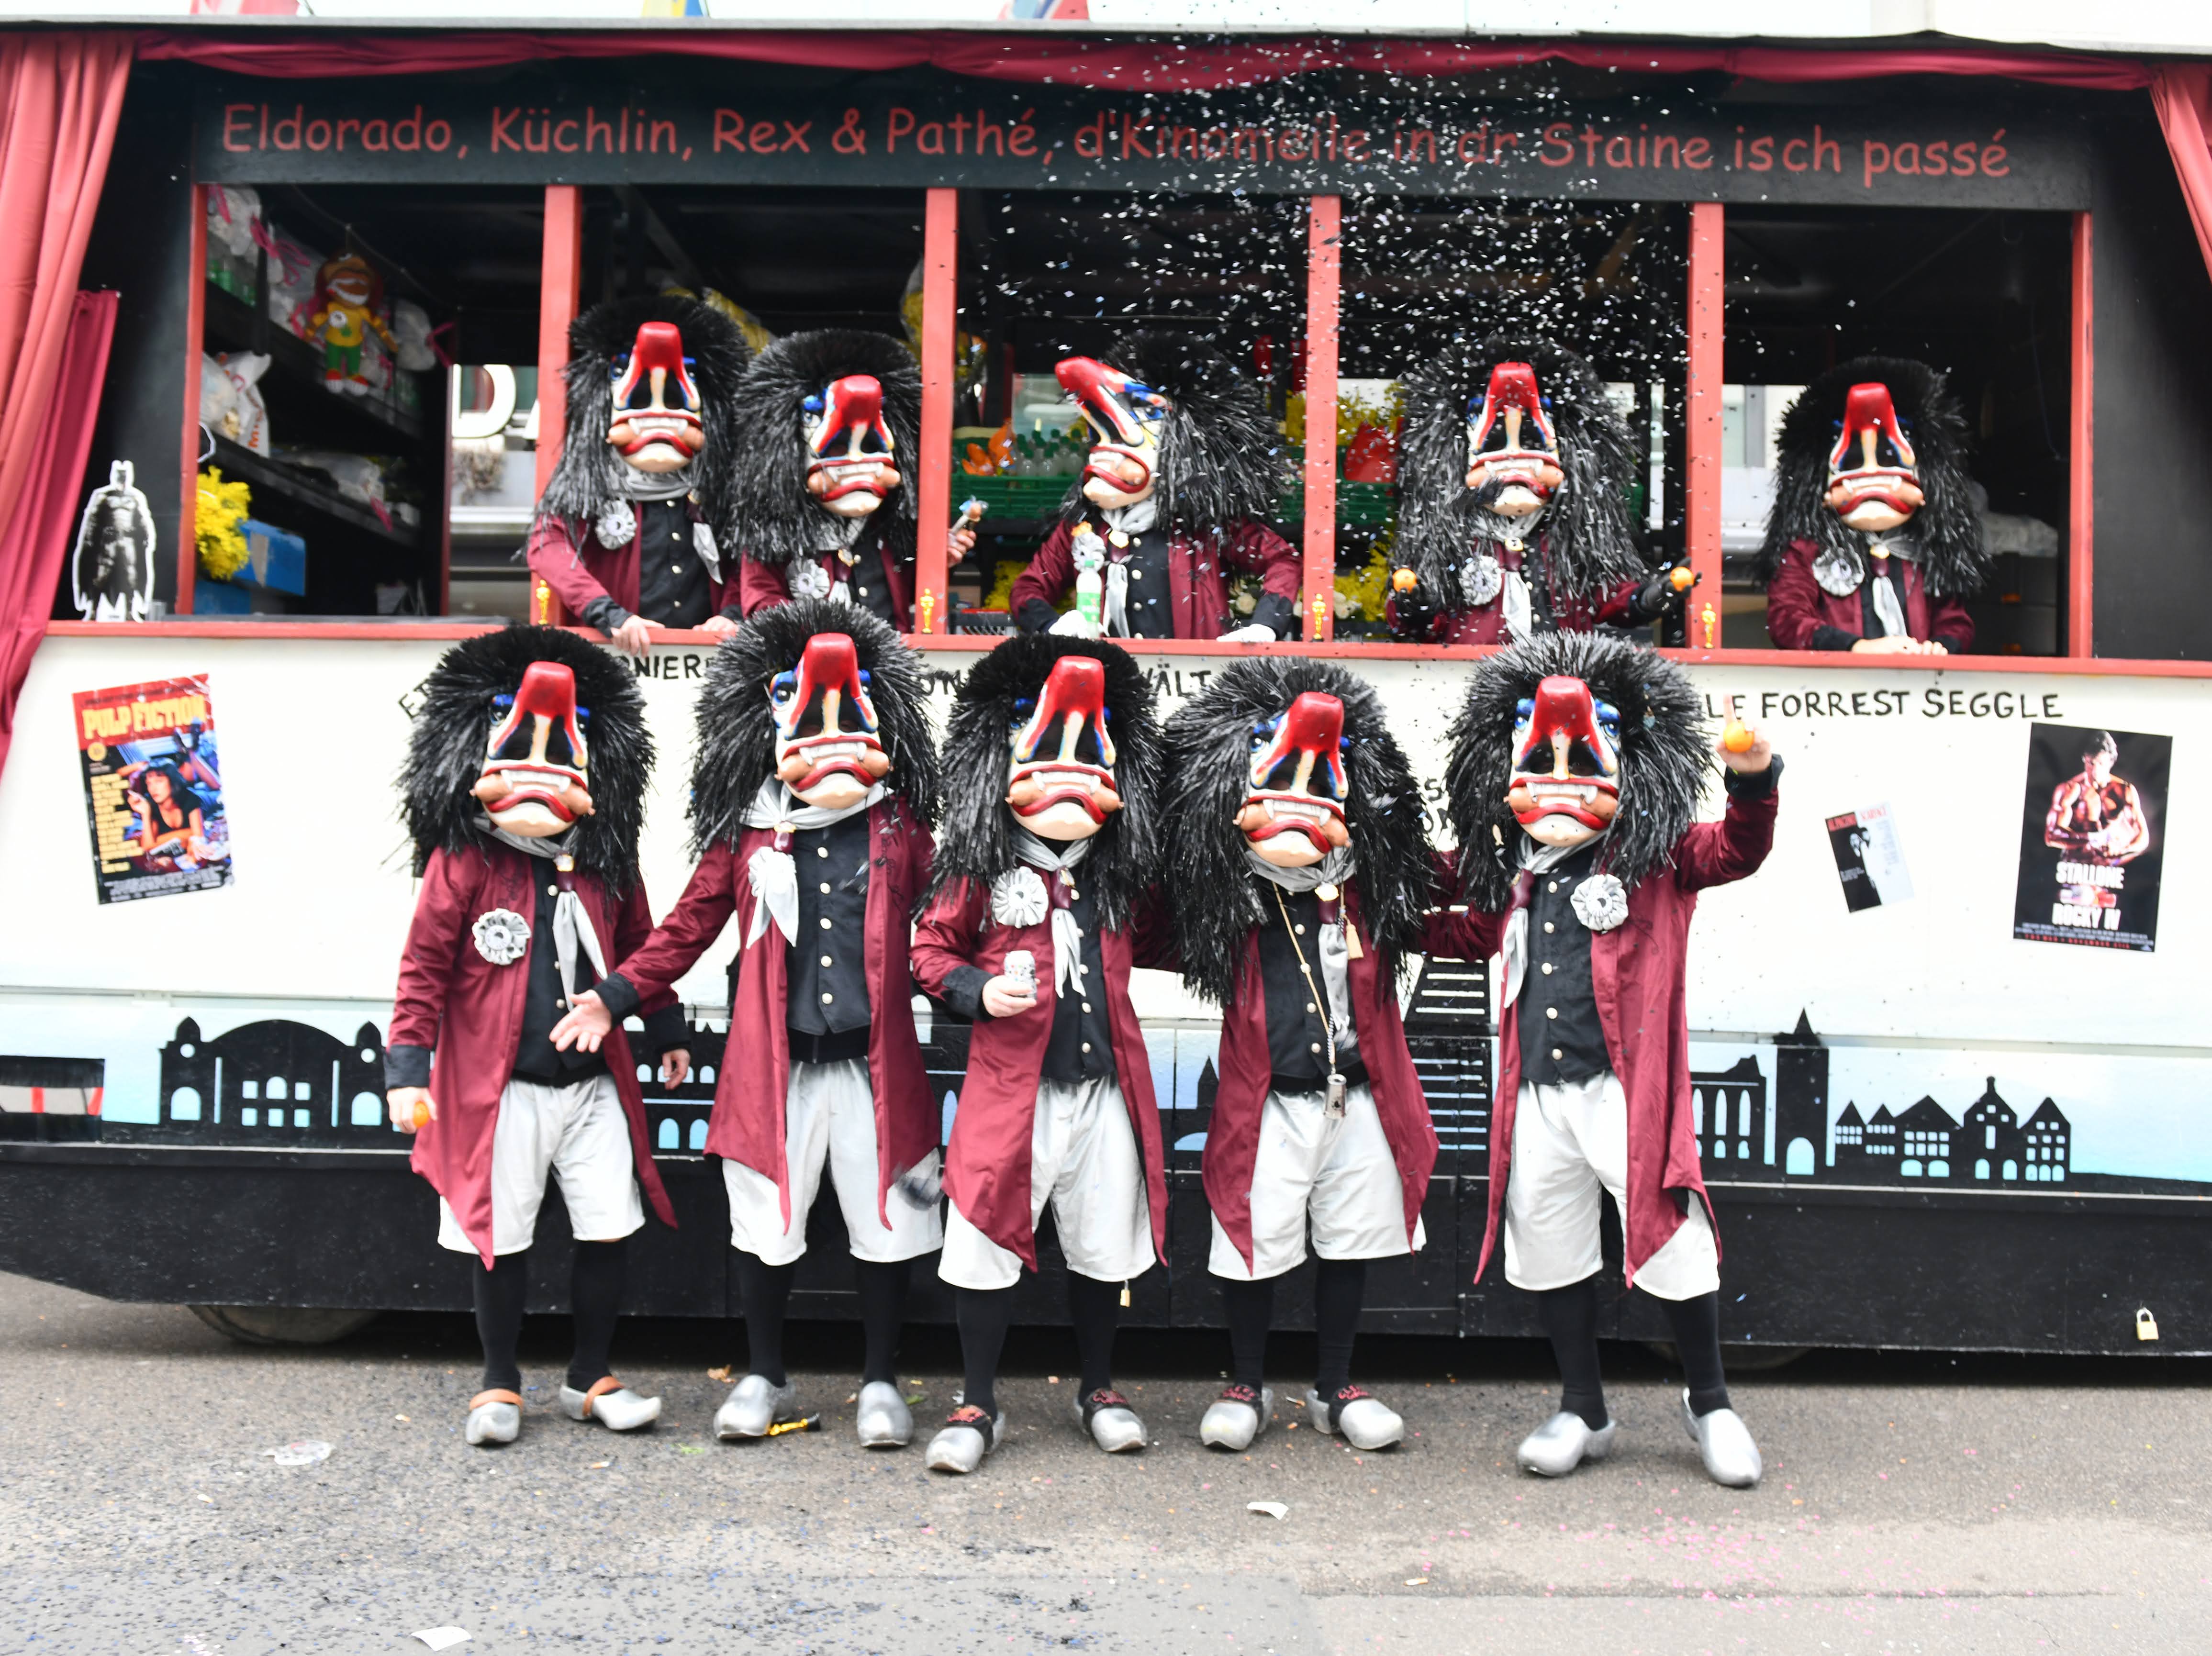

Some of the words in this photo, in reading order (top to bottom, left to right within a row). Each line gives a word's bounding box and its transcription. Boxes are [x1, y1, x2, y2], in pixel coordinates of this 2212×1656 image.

[225, 105, 468, 158] Eldorado,
[491, 108, 692, 160] Küchlin,
[714, 110, 810, 153] Rex
[832, 108, 866, 154] &
[887, 107, 1053, 165] Pathé,
[1395, 119, 1436, 164] in
[1457, 117, 1518, 165] dr
[1540, 122, 1712, 169] Staine
[1735, 125, 1842, 172] isch
[1864, 128, 2010, 188] passé
[82, 705, 132, 740] PULP
[130, 693, 206, 733] FICTION
[1762, 689, 1910, 719] FORREST
[1922, 688, 2063, 718] SEGGLE
[2055, 861, 2125, 890] STALLONE
